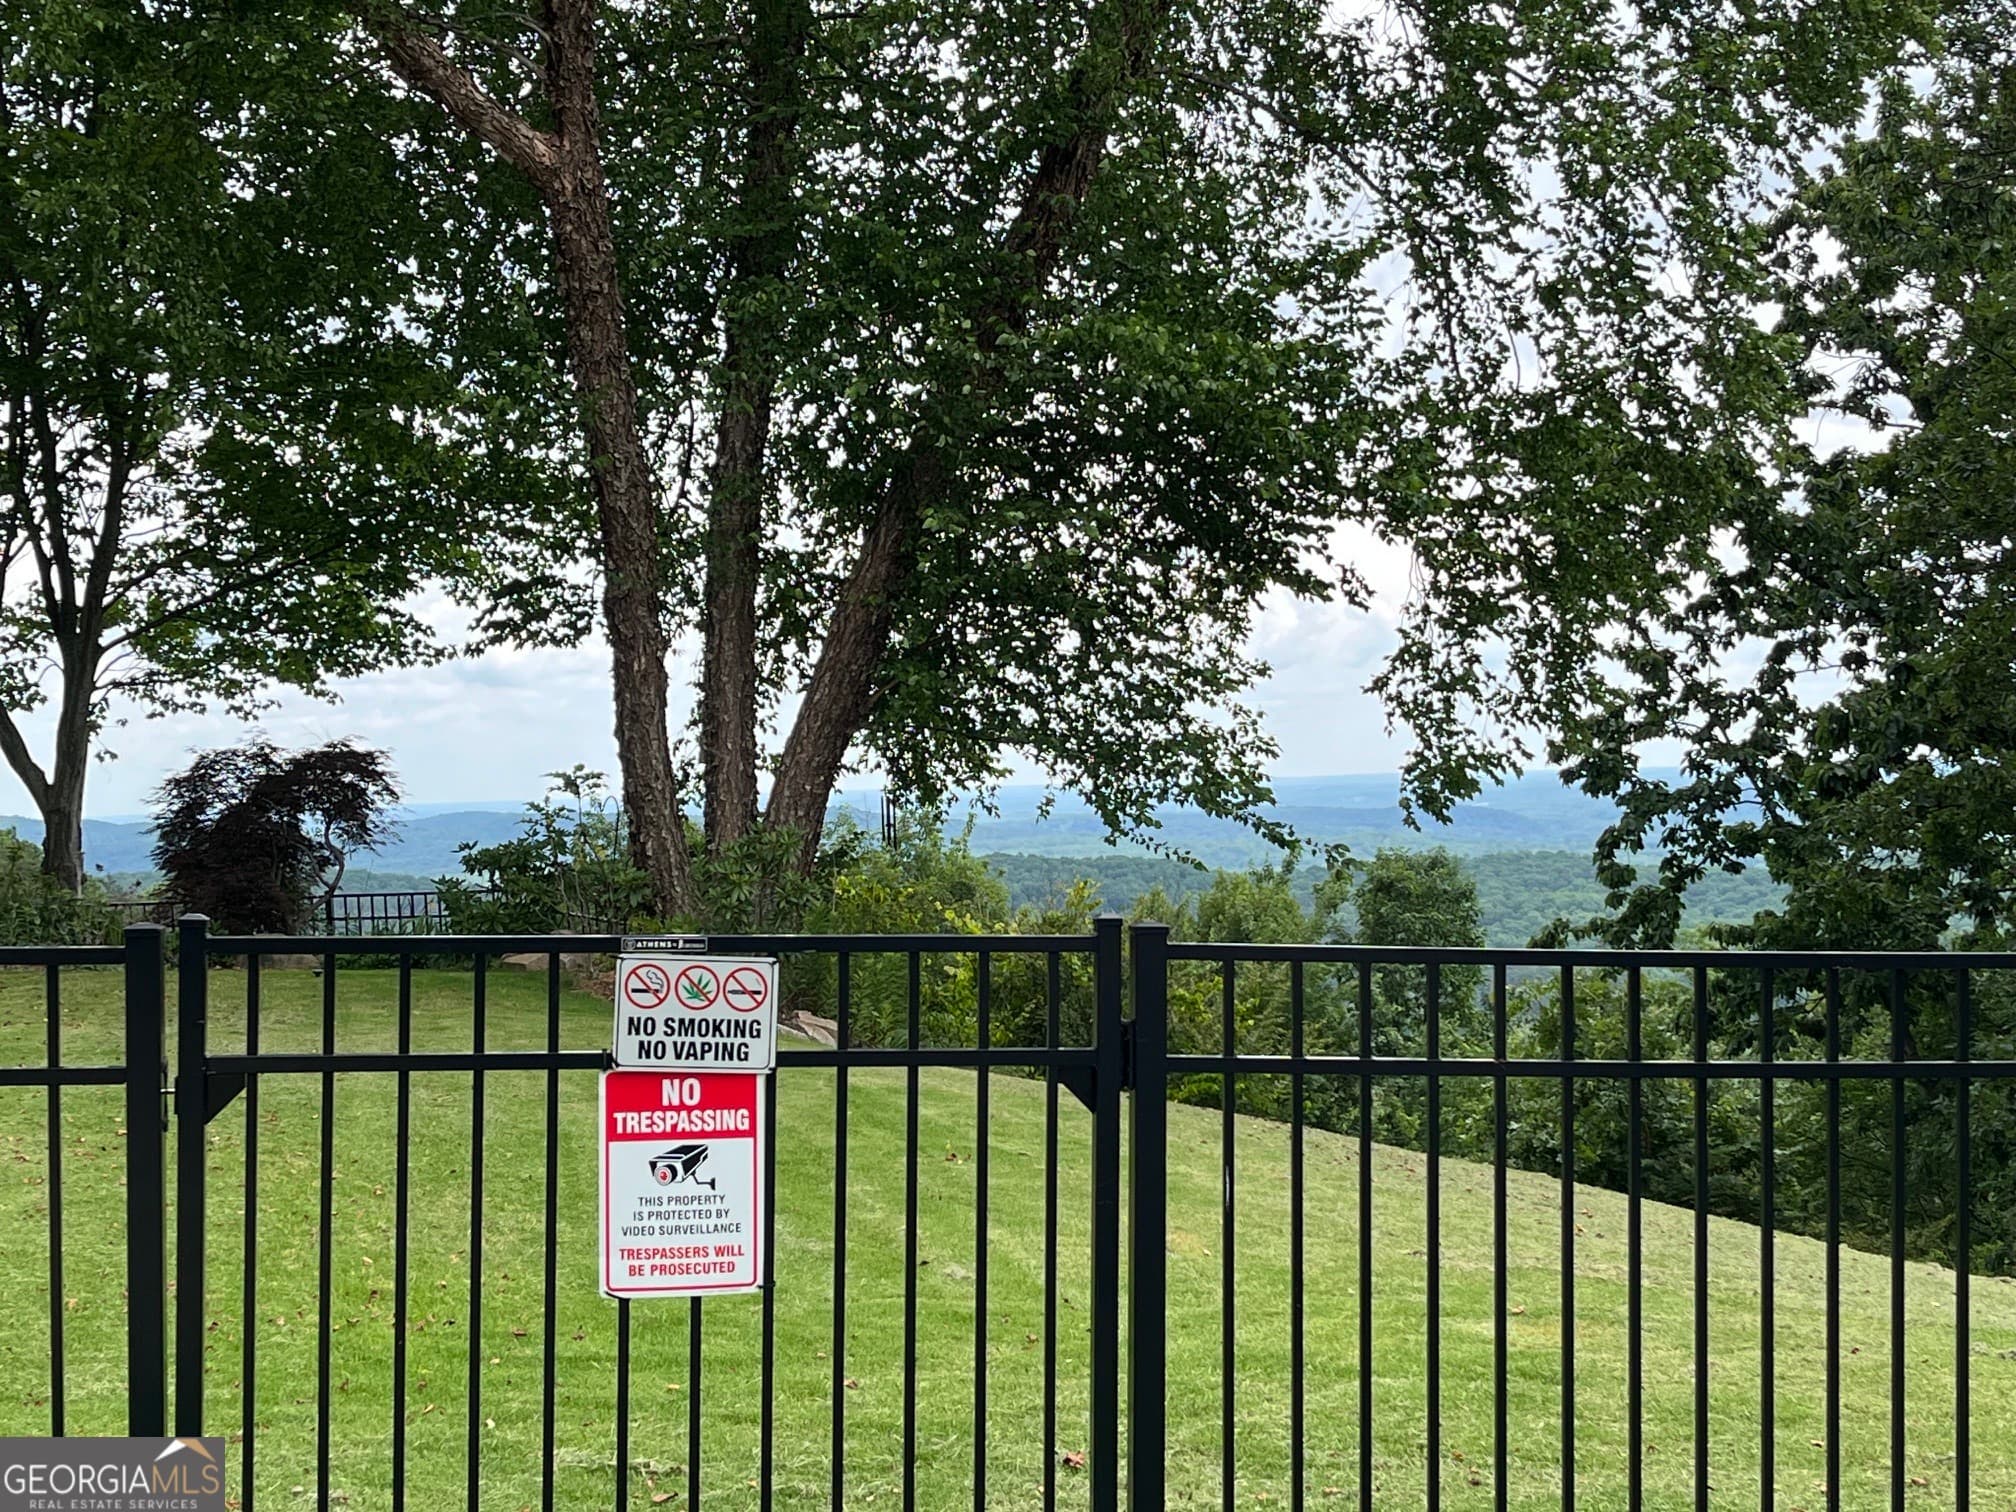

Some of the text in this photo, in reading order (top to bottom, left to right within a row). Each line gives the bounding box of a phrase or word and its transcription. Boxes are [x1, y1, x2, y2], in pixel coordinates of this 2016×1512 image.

[627, 1016, 762, 1039] NO SMOKING
[638, 1040, 750, 1062] NO VAPING
[661, 1078, 701, 1106] NO
[613, 1108, 750, 1134] TRESPASSING
[638, 1194, 726, 1207] THIS PROPERTY
[633, 1208, 730, 1221] IS PROTECTED BY
[621, 1222, 742, 1236] VIDEO SURVEILLANCE
[619, 1244, 745, 1261] TRESPASSERS WILL
[628, 1261, 736, 1277] BE PROSECUTED
